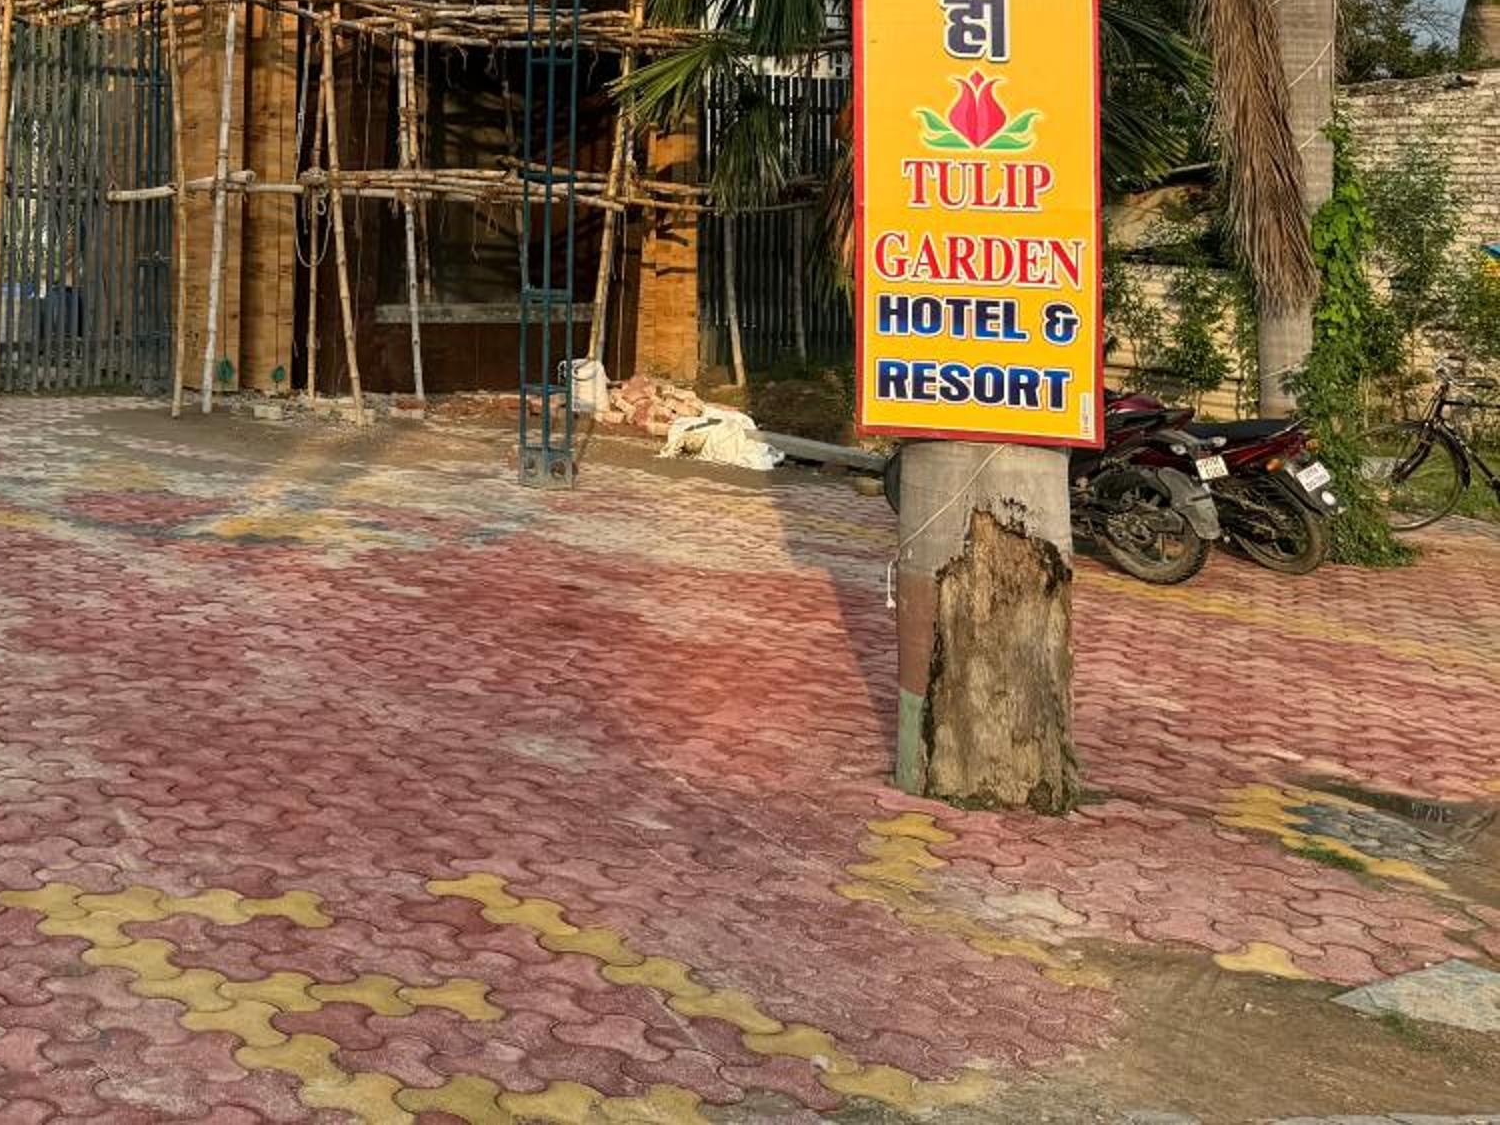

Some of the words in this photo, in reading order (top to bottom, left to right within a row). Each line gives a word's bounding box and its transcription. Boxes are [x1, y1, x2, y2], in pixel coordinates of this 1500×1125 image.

[903, 161, 1051, 209] TULIP
[875, 234, 1083, 287] GARDEN
[878, 295, 1027, 341] HOTEL
[1042, 303, 1079, 343] &
[877, 361, 1071, 410] RESORT
